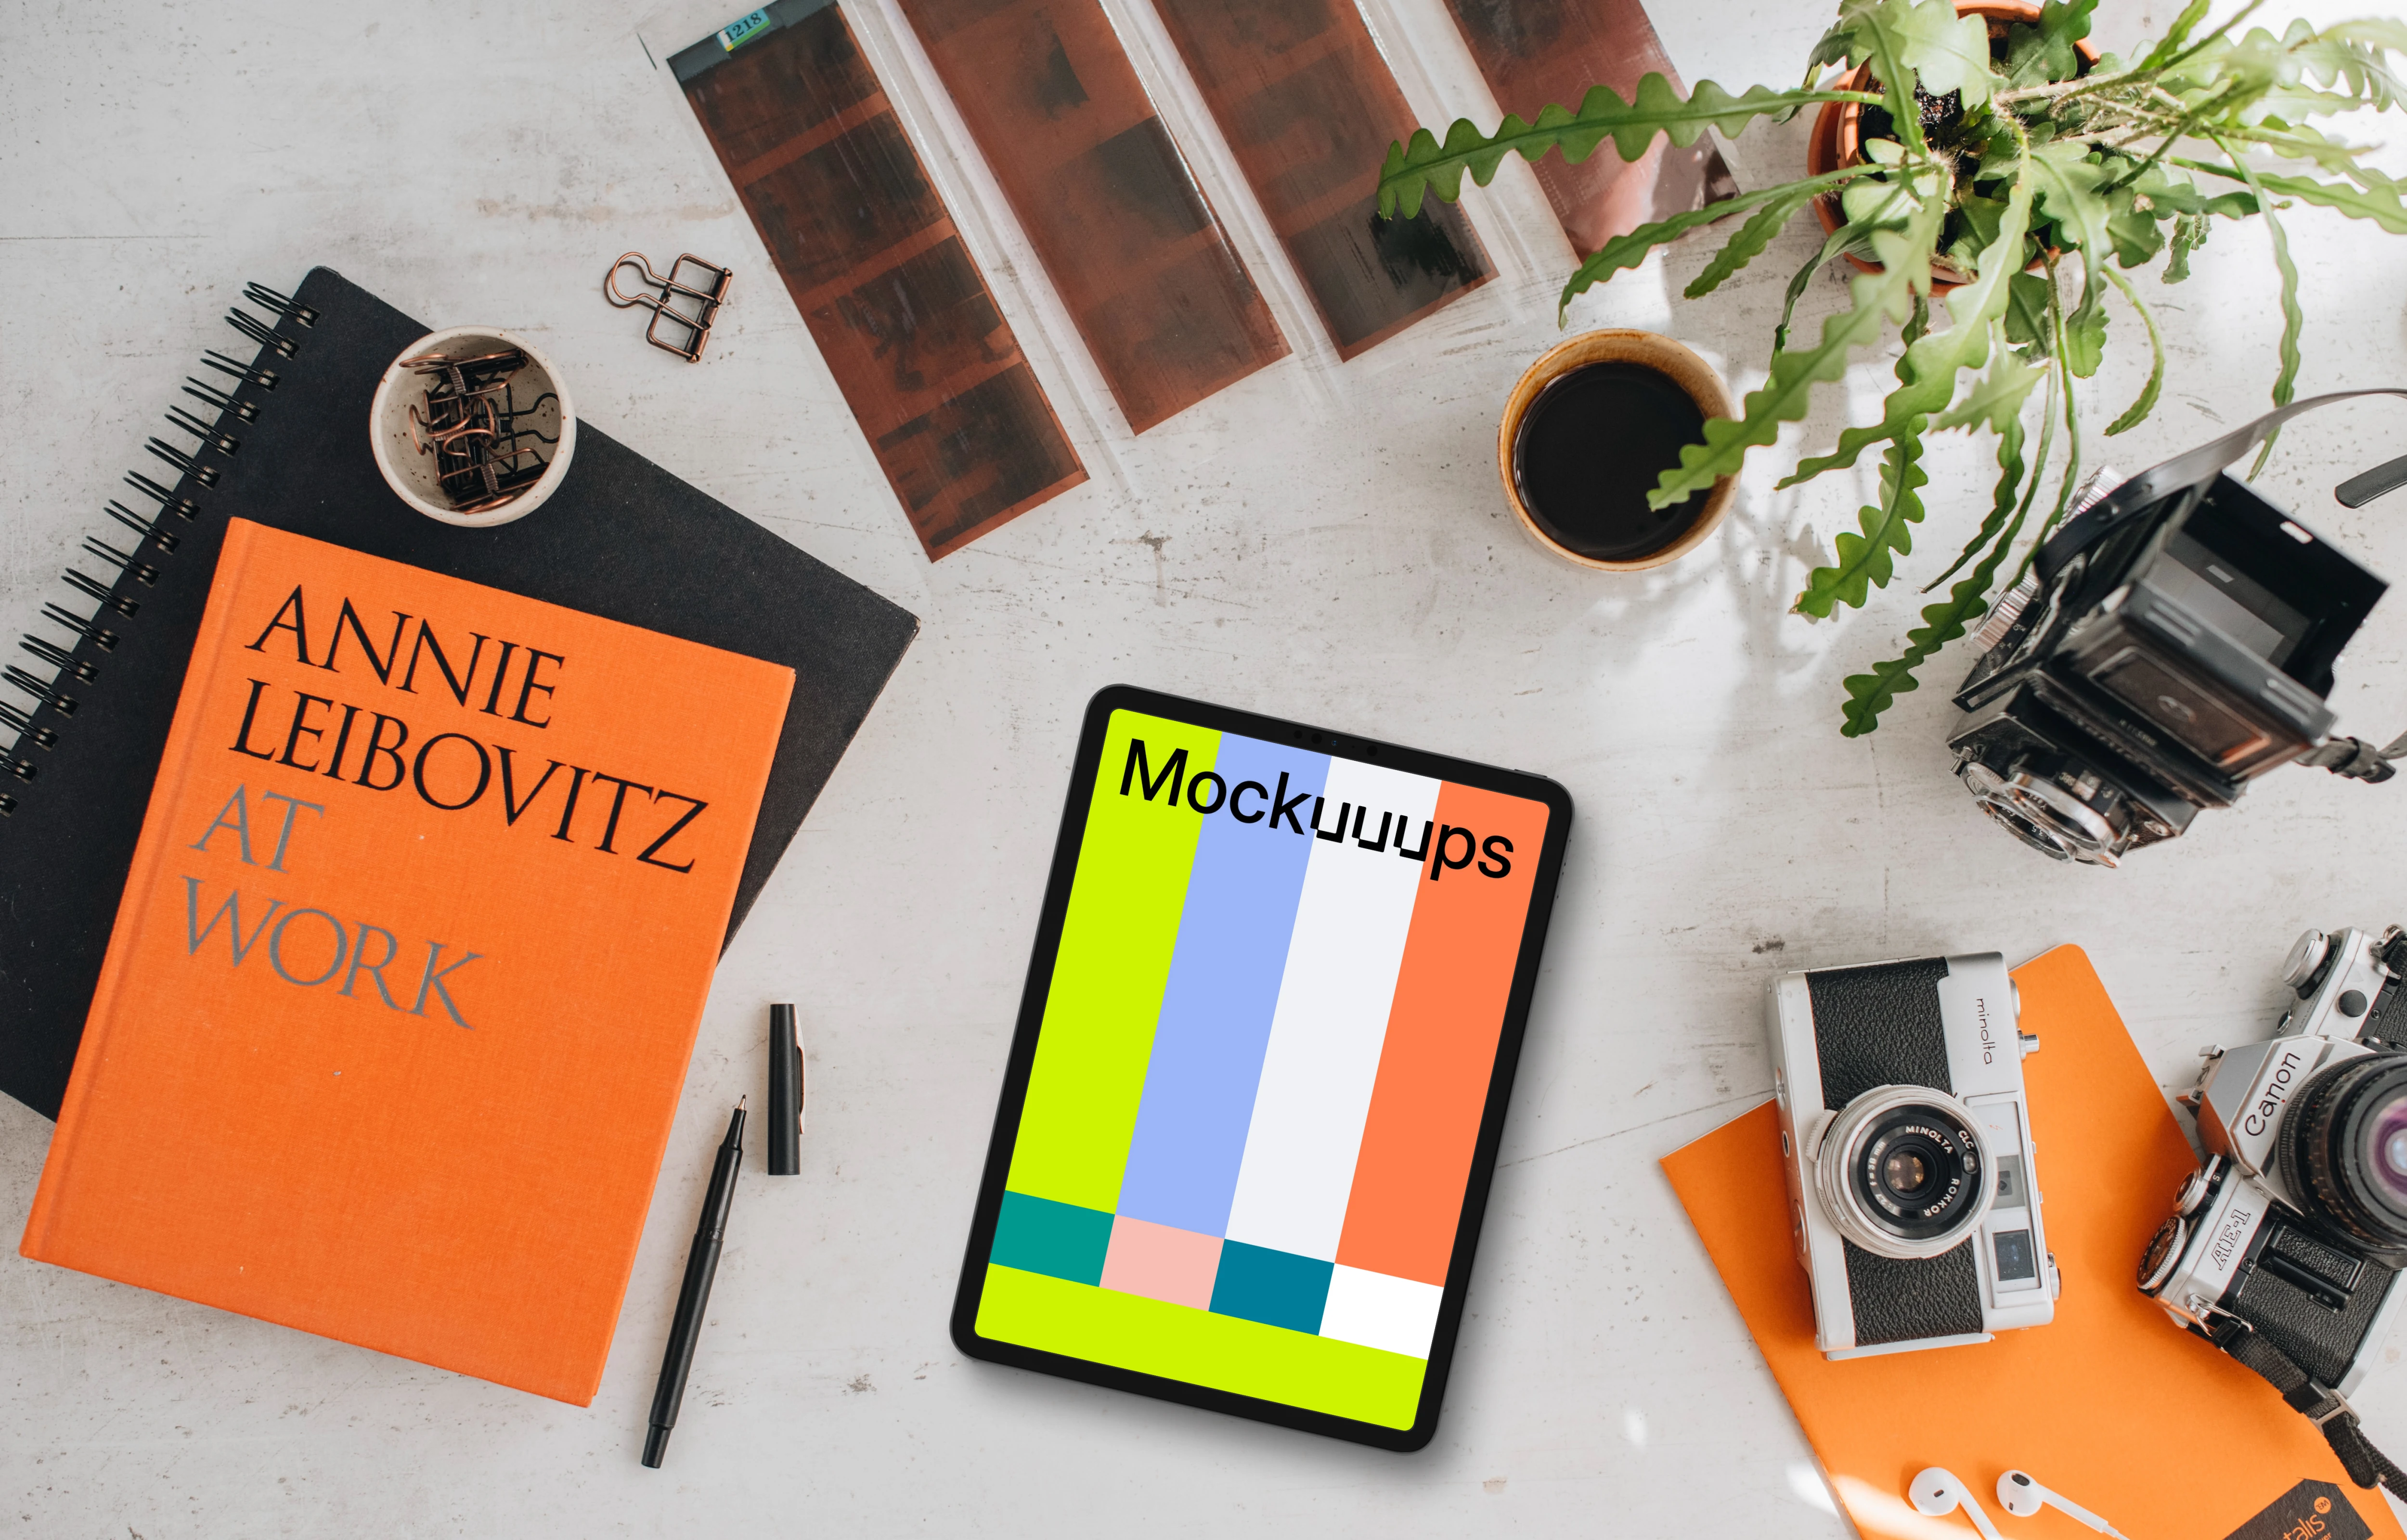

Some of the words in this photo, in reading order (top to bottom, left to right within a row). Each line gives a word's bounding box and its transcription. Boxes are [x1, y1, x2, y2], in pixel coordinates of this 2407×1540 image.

[725, 13, 762, 43] 1218
[245, 584, 565, 729] ANNIE
[229, 678, 709, 874] LEIBOVITZ
[2025, 793, 2046, 810] Yash
[188, 783, 325, 874] AT
[1120, 738, 1514, 881] Mockuuups
[180, 874, 483, 1030] WORK
[1976, 999, 1996, 1065] minolta
[2245, 1052, 2301, 1136] Canon
[1905, 1126, 1954, 1154] MINOLTA
[1958, 1130, 1974, 1149] CLC
[1923, 1178, 1961, 1217] ROKKOR
[2211, 1209, 2251, 1270] AE-1
